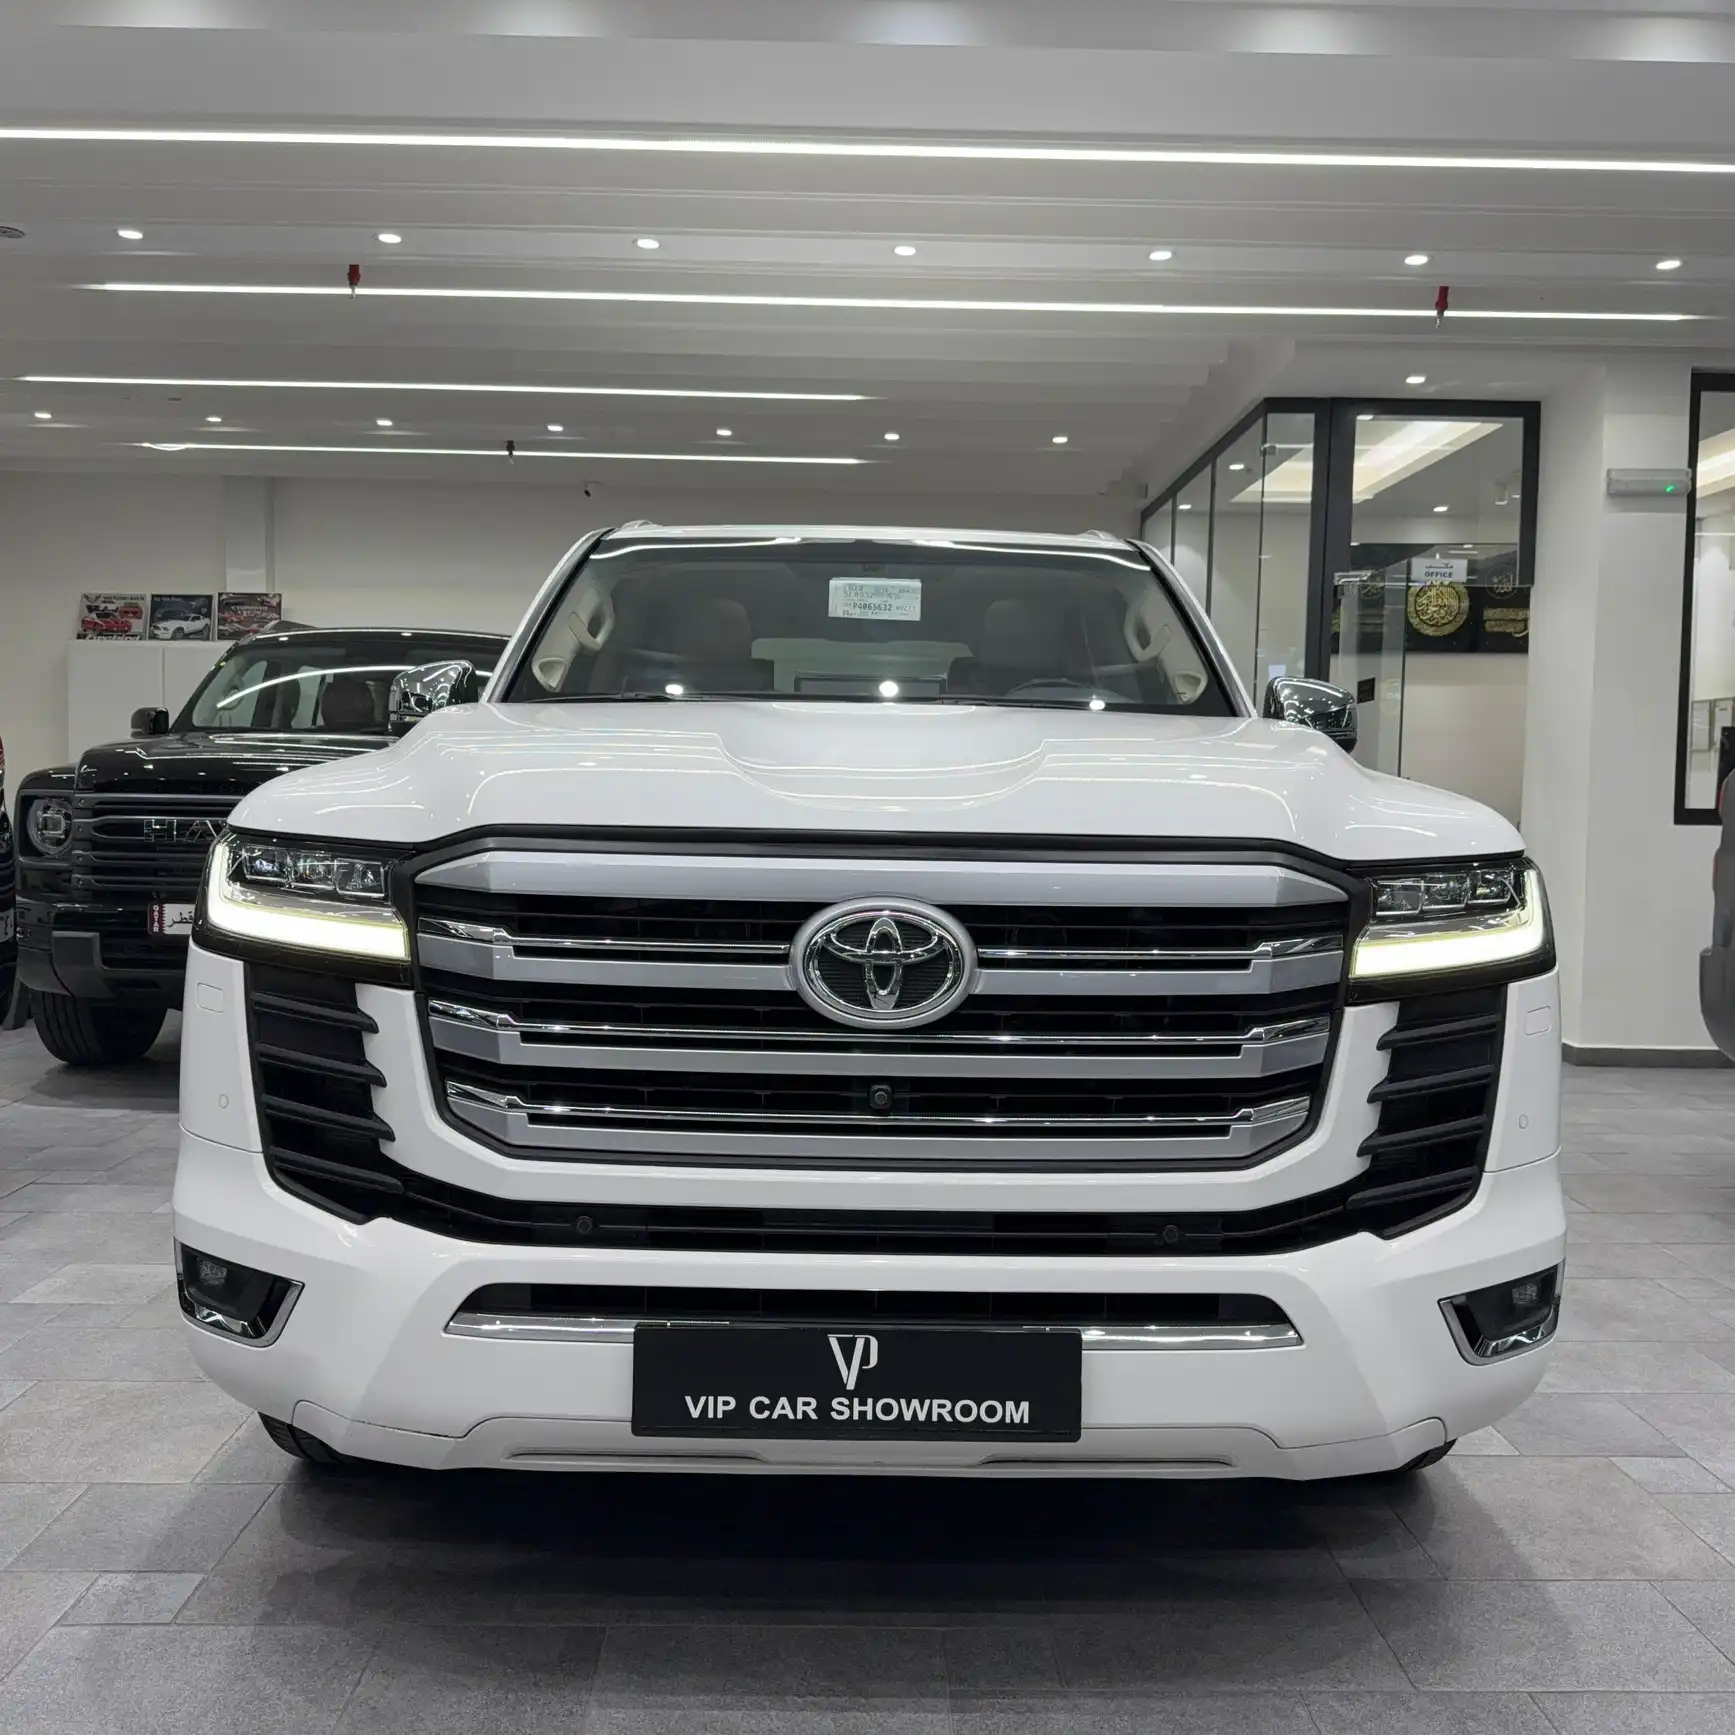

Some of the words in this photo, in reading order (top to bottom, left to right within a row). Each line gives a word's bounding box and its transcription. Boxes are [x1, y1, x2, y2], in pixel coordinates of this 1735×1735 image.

[1424, 571, 1454, 579] OFFICE
[852, 602, 893, 612] P4065632
[685, 1395, 736, 1420] VIP
[749, 1396, 818, 1420] CAR
[830, 1397, 1030, 1424] SHOWROOM
